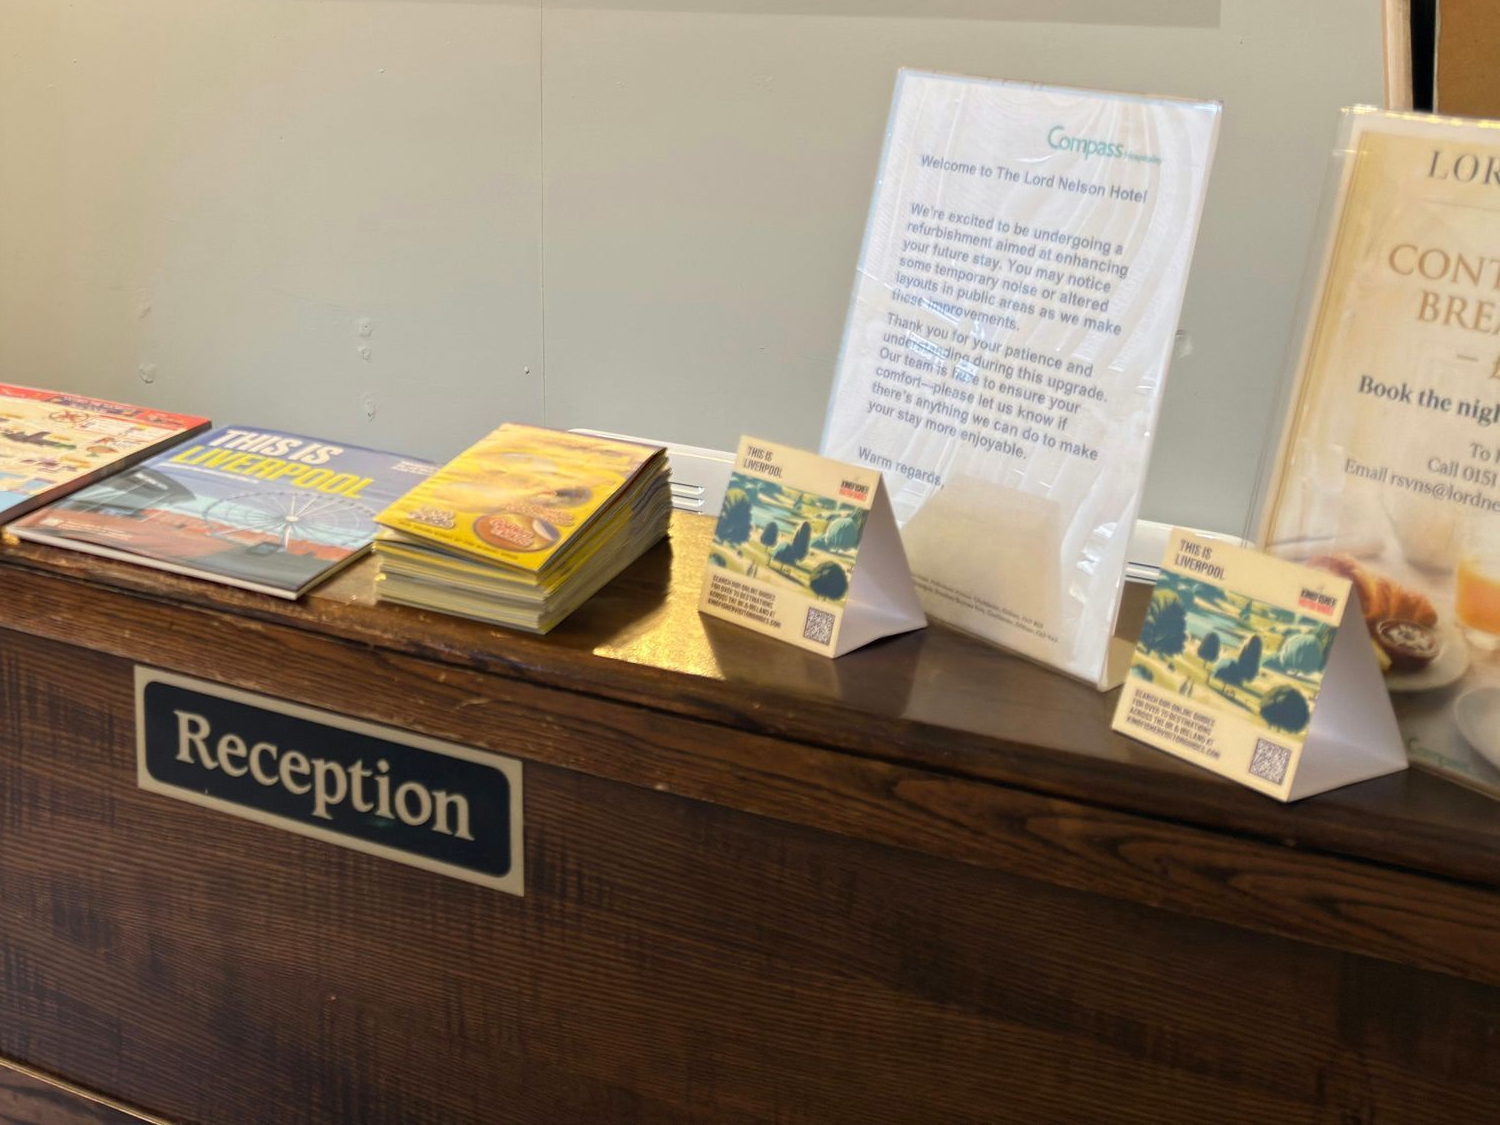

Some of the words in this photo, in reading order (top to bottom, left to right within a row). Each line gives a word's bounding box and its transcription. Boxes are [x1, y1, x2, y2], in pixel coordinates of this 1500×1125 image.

[1047, 125, 1124, 159] Compass
[920, 154, 976, 175] Welcome
[980, 164, 993, 178] to
[996, 166, 1020, 182] The
[1024, 168, 1055, 188] Lord
[1057, 177, 1105, 196] Nelson
[1109, 186, 1148, 203] Hotel
[907, 221, 992, 248] refurbishment
[995, 239, 1036, 257] aimed
[1039, 248, 1052, 261] at
[1055, 252, 1129, 279] enhancing
[911, 202, 945, 220] We're
[948, 212, 995, 230] excited
[997, 220, 1010, 232] to
[1013, 222, 1029, 236] be
[1034, 229, 1111, 255] undergoing
[1115, 244, 1124, 255] a
[899, 257, 932, 272] some
[935, 264, 999, 290] temporary
[1002, 279, 1037, 296] noise
[1041, 289, 1056, 300] or
[1059, 291, 1109, 312] altered
[902, 239, 929, 254] your
[932, 243, 969, 262] future
[972, 255, 1002, 271] stay.
[1008, 259, 1032, 275] You
[1035, 266, 1066, 285] may
[1068, 274, 1111, 293] notice
[895, 271, 939, 292] layouts
[942, 281, 954, 295] in
[956, 288, 996, 306] public
[998, 297, 1035, 315] areas
[1039, 307, 1056, 320] as
[1060, 311, 1080, 324] we
[1083, 317, 1122, 335] make
[927, 298, 1020, 331] improvements.
[1416, 290, 1500, 336] BRE
[887, 312, 923, 332] Thank
[926, 325, 949, 339] you
[952, 329, 970, 345] for
[971, 337, 1002, 352] your
[1004, 345, 1062, 369] patience
[1066, 362, 1093, 377] and
[880, 347, 902, 363] Our
[904, 356, 934, 373] team
[936, 364, 948, 376] is
[983, 376, 996, 390] to
[998, 383, 1046, 404] ensure
[1048, 396, 1080, 413] your
[972, 355, 1014, 379] during
[1017, 367, 1043, 384] this
[1048, 376, 1108, 403] upgrade.
[1357, 374, 1413, 404] Book
[1418, 388, 1453, 412] the
[867, 400, 895, 418] your
[897, 410, 923, 428] stay
[925, 418, 957, 437] more
[960, 429, 1027, 460] enjoyable.
[872, 381, 913, 403] there's
[915, 395, 969, 424] anything
[972, 413, 990, 427] we
[993, 420, 1018, 436] can
[1021, 427, 1039, 442] do
[1042, 434, 1056, 448] to
[1060, 439, 1099, 460] make
[978, 394, 994, 410] let
[997, 401, 1013, 415] us
[1018, 405, 1054, 427] know
[1057, 416, 1068, 430] if
[208, 430, 296, 456] THIS
[288, 440, 345, 466] IS
[743, 458, 783, 478] LIVERPOOL
[747, 445, 765, 460] THIS
[765, 450, 774, 462] IS
[858, 446, 892, 470] Warm
[1344, 458, 1388, 483] Email
[1469, 442, 1491, 461] To
[170, 445, 375, 499] LIVERPOOL
[1427, 456, 1459, 477] Call
[1462, 465, 1498, 488] 0151
[1175, 552, 1226, 580] LIVERPOOL
[1180, 538, 1201, 555] THIS
[1201, 545, 1213, 560] IS
[173, 709, 475, 841] Reception
